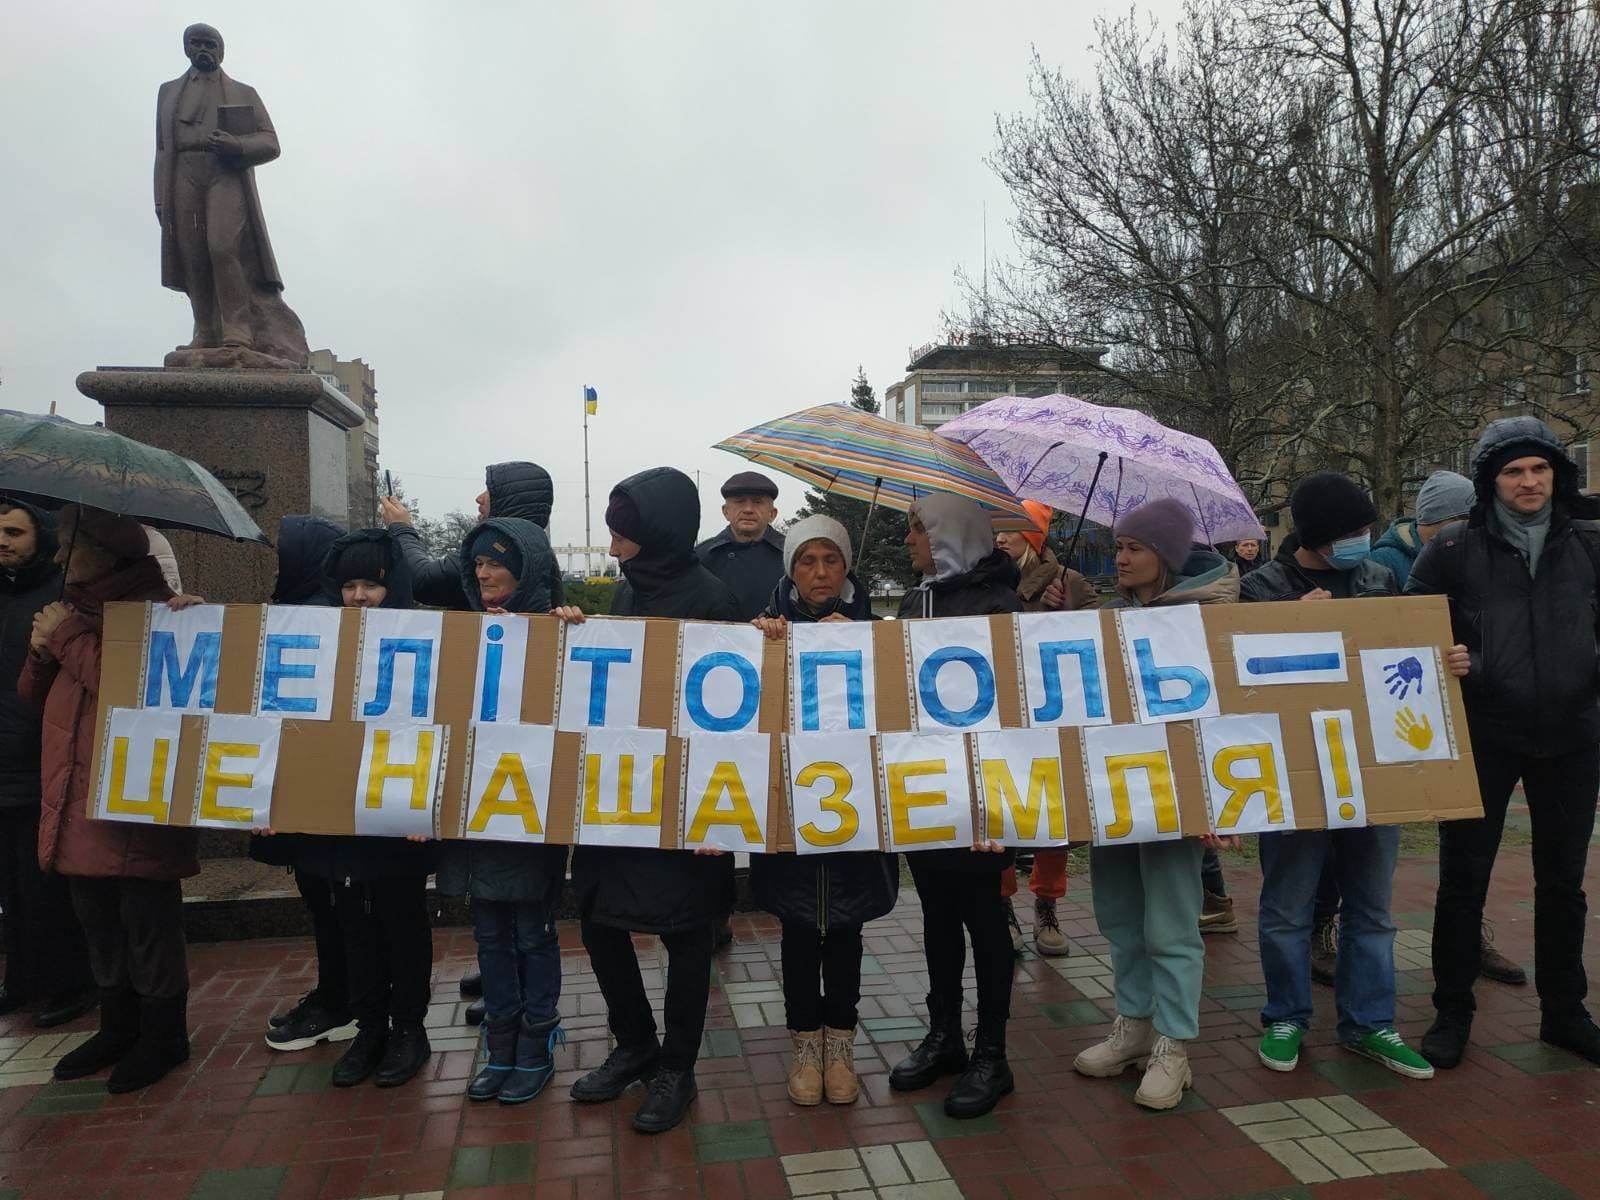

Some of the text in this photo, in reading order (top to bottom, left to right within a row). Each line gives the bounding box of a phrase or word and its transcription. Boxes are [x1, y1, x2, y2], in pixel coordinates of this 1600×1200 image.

[106, 718, 1355, 846] ЦЕ НАША ЗЕМЛЯ!
